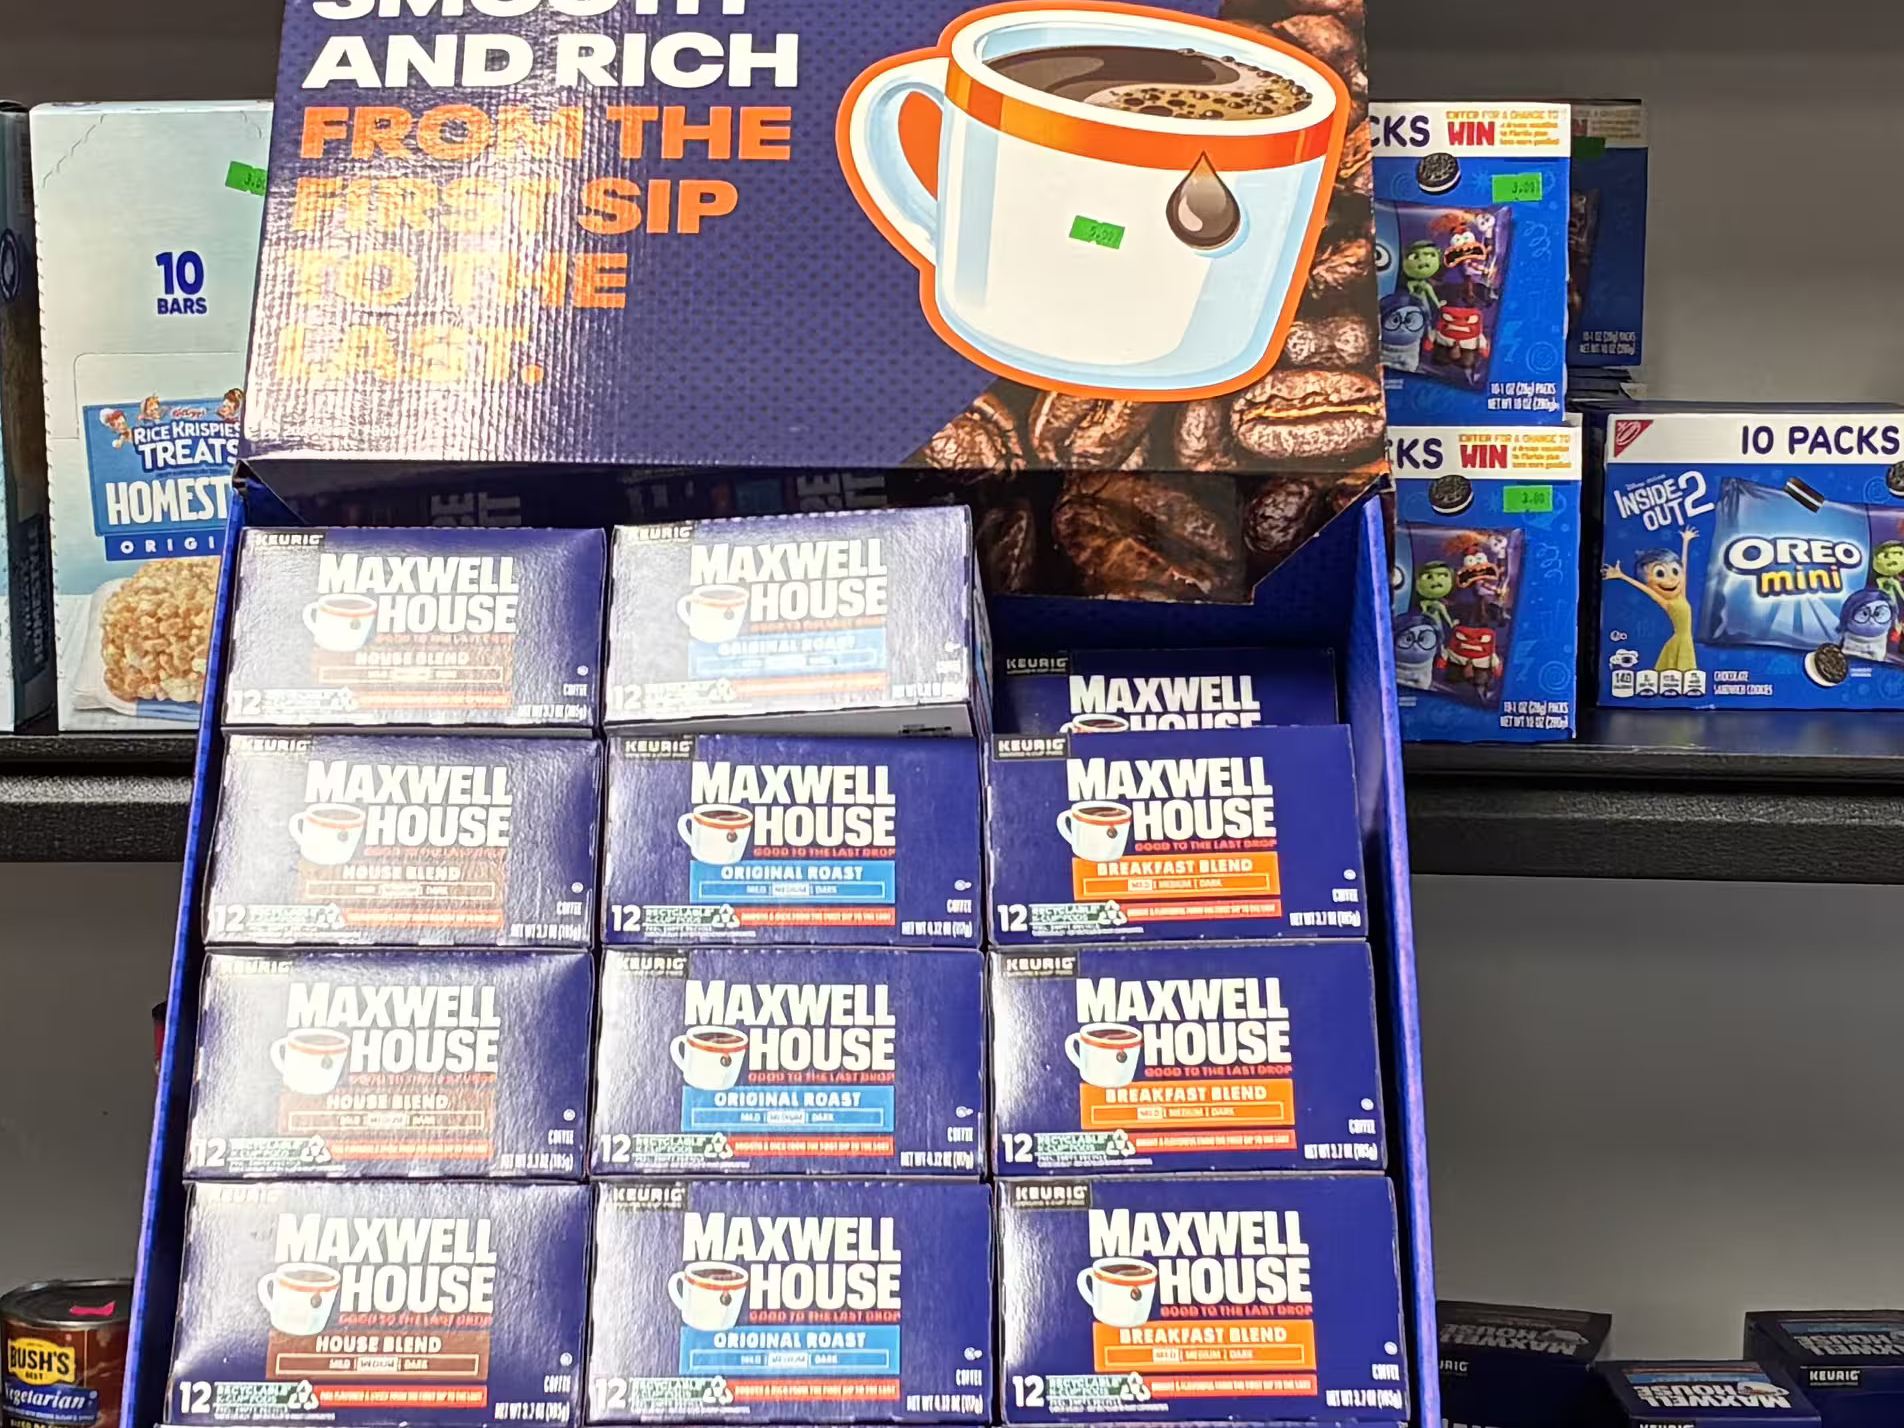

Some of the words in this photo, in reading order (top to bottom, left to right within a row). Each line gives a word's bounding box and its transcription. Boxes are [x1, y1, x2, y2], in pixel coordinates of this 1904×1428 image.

[302, 34, 533, 88] AND
[553, 33, 799, 89] RICH
[299, 105, 580, 159] FROM
[606, 105, 791, 160] THE
[1447, 123, 1495, 147] WIN
[602, 177, 737, 234] SIP
[155, 251, 205, 294] 10
[157, 298, 208, 315] BARS
[1789, 426, 1901, 455] PACKS
[1678, 470, 1715, 518] 2
[1728, 538, 1862, 570] OREO
[1760, 567, 1842, 593] mini
[1069, 675, 1260, 714] MAXWELL
[691, 760, 897, 805] MAXWELL
[1066, 756, 1273, 801] MAXWELL
[754, 804, 896, 848] HOUSE
[1132, 797, 1276, 840] HOUSE
[721, 865, 802, 881] ORIGINAL
[806, 864, 863, 881] ROAST
[1097, 860, 1195, 877] BREAKFAST
[1199, 859, 1253, 873] BLEND
[684, 983, 896, 1027] MAXWELL
[1076, 977, 1289, 1023] MAXWELL
[748, 1027, 896, 1072] HOUSE
[1144, 1021, 1292, 1066] HOUSE
[274, 1214, 498, 1265] MAXWELL
[682, 1214, 902, 1263] MAXWELL
[1089, 1209, 1310, 1257] MAXWELL
[338, 1263, 495, 1313] HOUSE
[749, 1261, 901, 1311] HOUSE
[1159, 1257, 1313, 1304] HOUSE
[10, 1347, 70, 1377] BUSH'S
